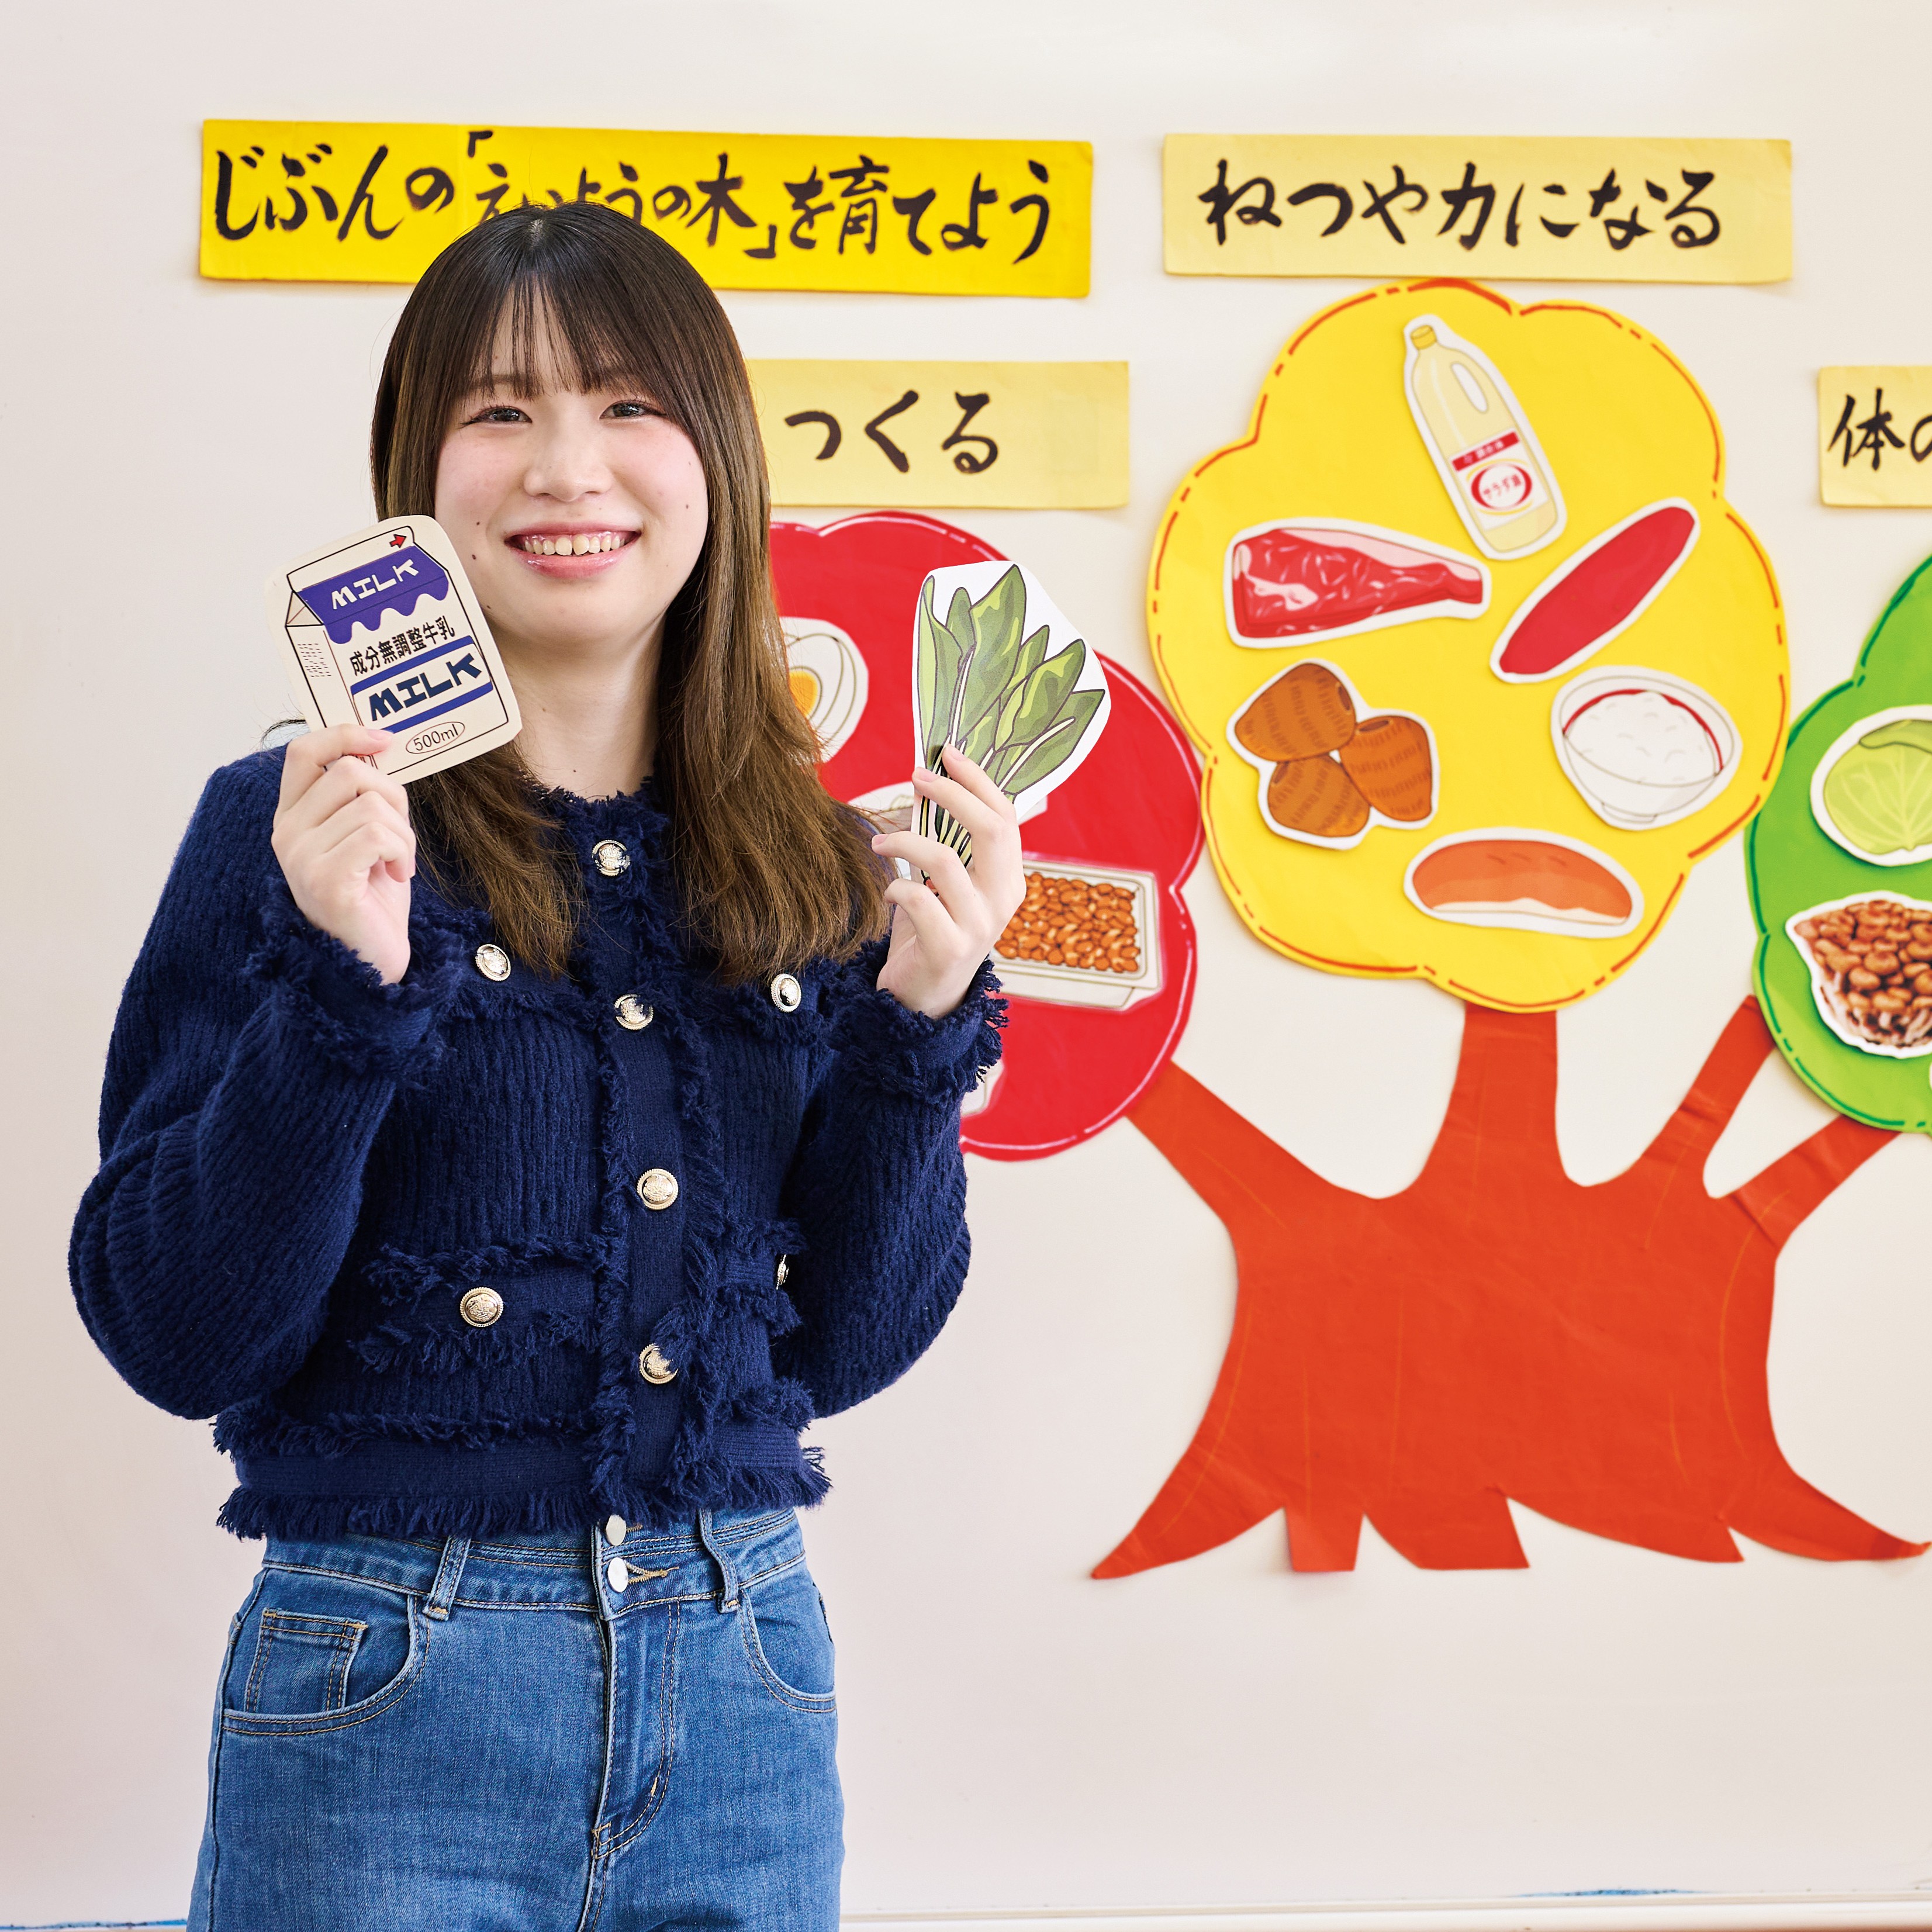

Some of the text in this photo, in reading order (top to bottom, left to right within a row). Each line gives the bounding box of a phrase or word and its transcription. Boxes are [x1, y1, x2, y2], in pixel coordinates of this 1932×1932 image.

[215, 130, 1050, 264] じぶんの「えうの木」を育てよう
[1198, 159, 1720, 250] ねつや力になる
[784, 390, 998, 474] つくる
[332, 559, 419, 610] MILK
[349, 615, 455, 676] 成分無調整牛乳
[368, 652, 483, 721] MILK
[413, 723, 459, 752] 500ml
